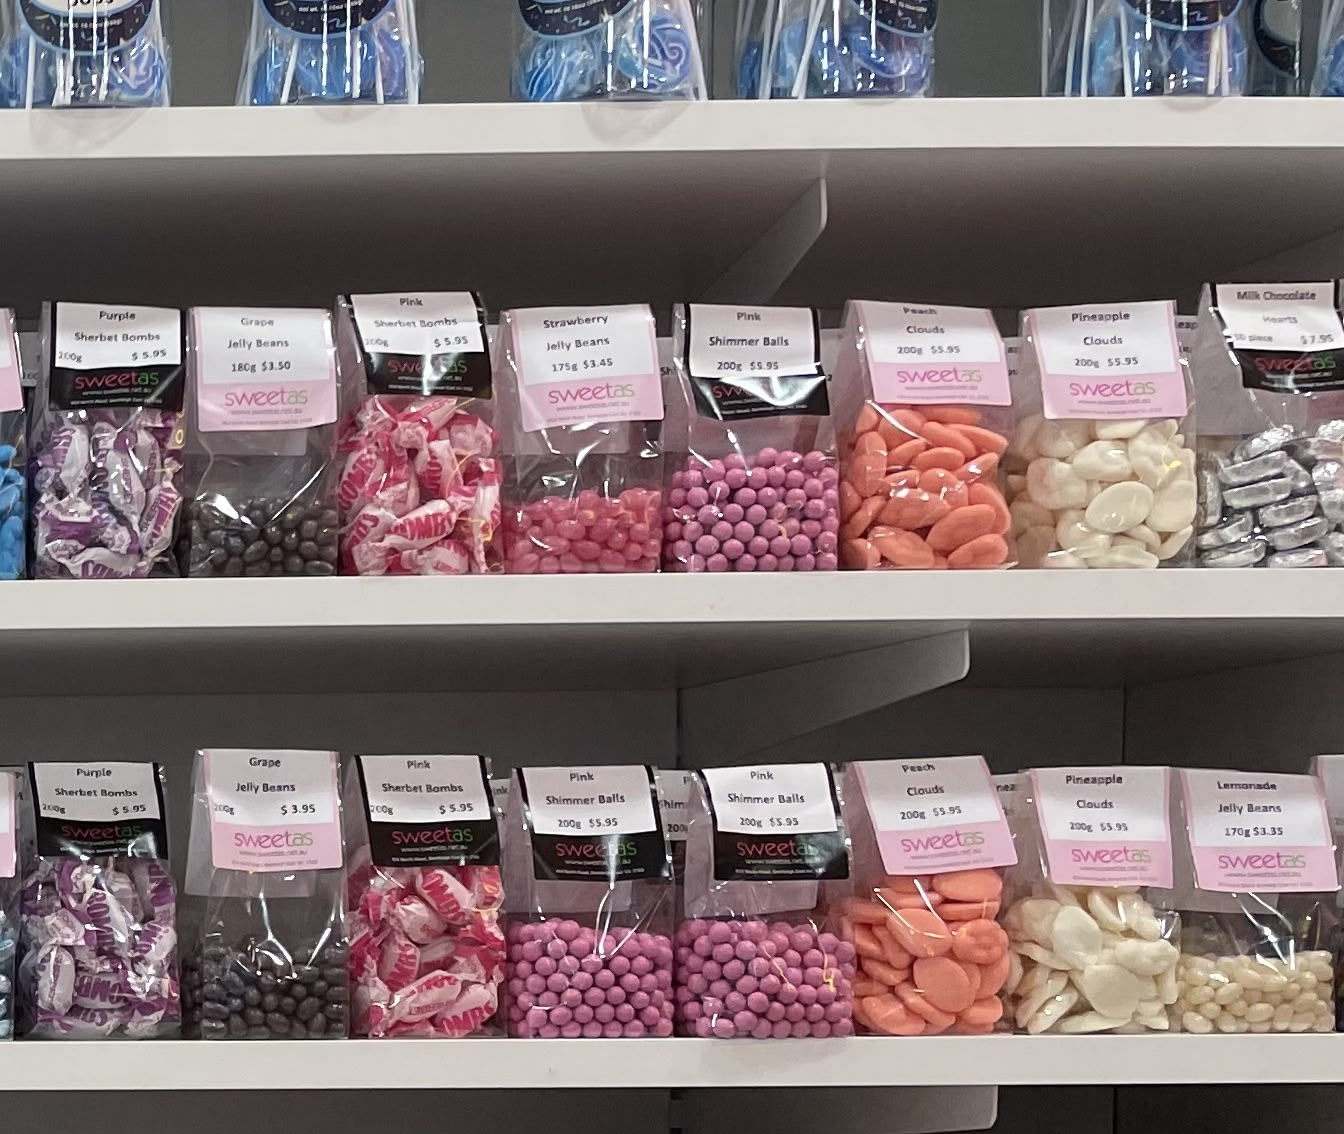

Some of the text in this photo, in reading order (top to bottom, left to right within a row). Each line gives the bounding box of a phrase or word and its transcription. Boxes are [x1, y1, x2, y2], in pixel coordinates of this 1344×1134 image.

[1237, 290, 1317, 301] Milk Chocolate
[99, 310, 135, 321] Purple
[737, 311, 761, 321] Pink
[1071, 310, 1129, 324] Pineapple
[241, 317, 274, 329] Grape
[543, 315, 608, 330] Strawberry
[75, 332, 160, 342] Sherbet Bombs
[709, 336, 789, 347] Shimmer Balls
[1083, 336, 1122, 346] Clouds
[228, 338, 289, 350] Jelly Beans
[546, 337, 610, 352] Jelly Beans
[231, 361, 290, 373] 180g $3.50
[552, 359, 613, 373] 175g $3.45
[717, 360, 778, 372] 200g $5.95
[75, 370, 159, 390] sweetas
[407, 760, 430, 770] Pink
[1065, 774, 1123, 786] Pineapple
[1217, 781, 1277, 791] Lemonade
[382, 783, 463, 793] Sherbet Bombs
[1076, 799, 1113, 809] Clouds
[1218, 803, 1282, 815] Jelly Beans
[1225, 826, 1283, 837] 170g $3.35
[1072, 847, 1151, 863] sweetas
[1218, 853, 1306, 869] sweetas
